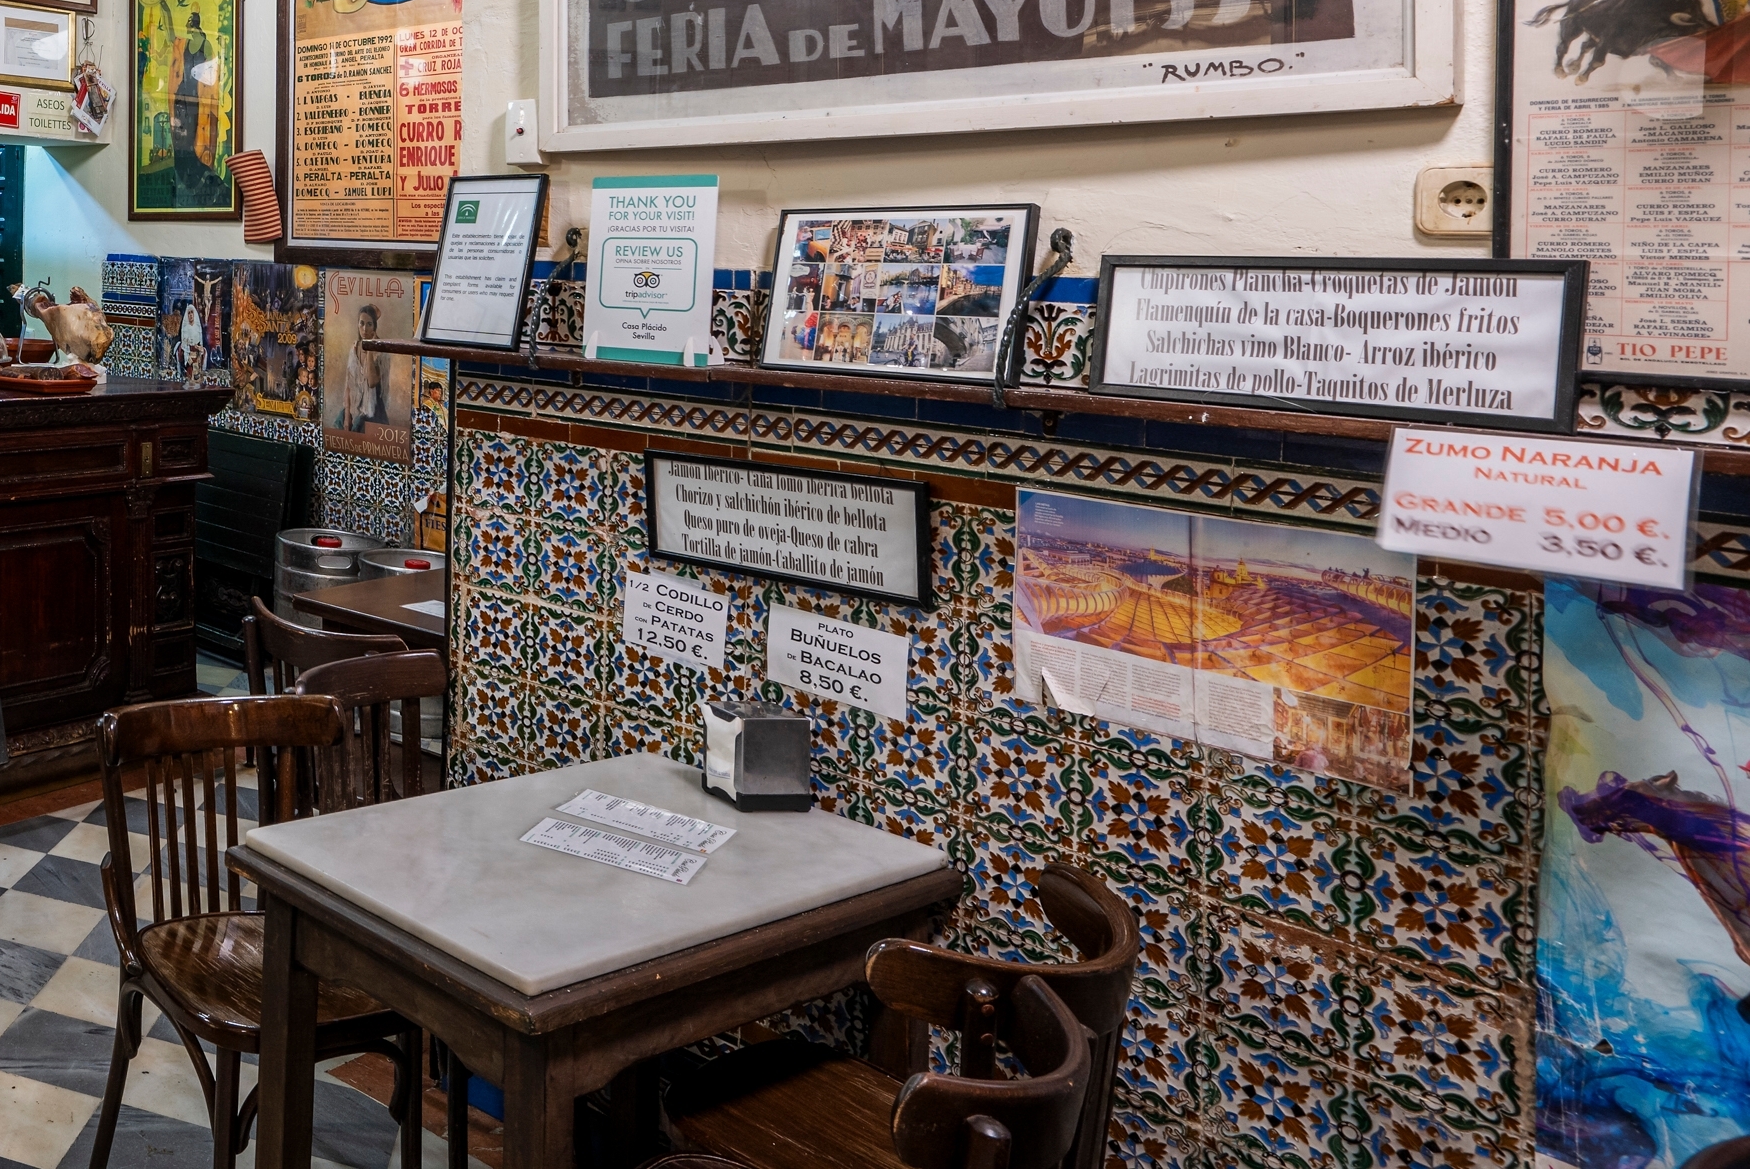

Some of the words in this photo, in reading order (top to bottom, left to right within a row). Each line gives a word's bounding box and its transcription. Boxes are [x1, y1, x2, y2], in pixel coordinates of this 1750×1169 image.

[298, 43, 327, 54] DOMINGO
[343, 37, 376, 47] OCTUBRE
[378, 35, 392, 44] 1992
[607, 4, 780, 79] FERIA
[788, 23, 865, 63] DE
[37, 99, 65, 110] ASEOS
[29, 118, 71, 130] TOILETTES
[400, 121, 444, 143] CURRO
[400, 145, 455, 167] ENRIQUE
[400, 176, 407, 191] Y
[609, 196, 658, 208] THANK
[663, 196, 696, 208] YOU
[609, 211, 628, 220] FOR
[633, 211, 662, 220] YOUR
[666, 211, 694, 220] VISIT!
[615, 246, 662, 257] REVIEW
[667, 247, 683, 257] US
[328, 271, 404, 314] SEVILLA
[1416, 272, 1438, 297] de
[1445, 272, 1518, 298] Jamón
[622, 322, 639, 330] Casa
[641, 322, 667, 331] Plácido
[1136, 299, 1232, 328] Flamenquín
[1238, 300, 1258, 325] de
[1264, 301, 1279, 326] la
[1286, 303, 1452, 334] casa-Boquerones
[1457, 307, 1520, 335] fritos
[278, 333, 298, 345] 2009
[633, 332, 655, 340] Sevilla
[1146, 330, 1235, 357] Salchichas
[1240, 335, 1277, 358] vino
[1283, 336, 1351, 363] Blanco-
[1358, 340, 1416, 368] Arroz
[1422, 341, 1496, 371] ibérico
[1617, 343, 1656, 356] TIO
[1670, 345, 1728, 361] PEPE
[1129, 362, 1221, 389] Lagrimitas
[1226, 366, 1246, 391] de
[1251, 369, 1389, 403] pollo-Taquitos
[1396, 377, 1418, 404] de
[1425, 379, 1513, 410] Merluza
[325, 434, 354, 451] FIESTAS
[362, 442, 409, 461] PRIMAVERA
[377, 427, 406, 444] 2013
[1405, 438, 1491, 460] ZUMO
[1502, 446, 1663, 476] NARANJA
[1474, 466, 1587, 490] NATURAL
[675, 484, 714, 506] Chorizo
[717, 493, 722, 511] y
[725, 492, 781, 517] salchichón
[784, 499, 823, 522] ibérico
[827, 505, 840, 525] de
[844, 507, 887, 532] bellota
[1394, 491, 1527, 522] GRANDE
[1543, 507, 1625, 533] 5,00
[1392, 515, 1492, 544] MEDIO
[1539, 532, 1623, 560] 3,50
[629, 579, 649, 592] 1/2
[656, 585, 723, 612] CODILLO
[655, 601, 703, 623] CERDO
[635, 616, 647, 624] CON
[651, 615, 714, 642] PATATAS
[637, 628, 687, 653] 12,50
[818, 623, 854, 639] PLATO
[790, 629, 881, 665] BUÑUELOS
[787, 653, 797, 661] DE
[801, 651, 882, 685] BACALAO
[800, 670, 844, 694] 8,50
